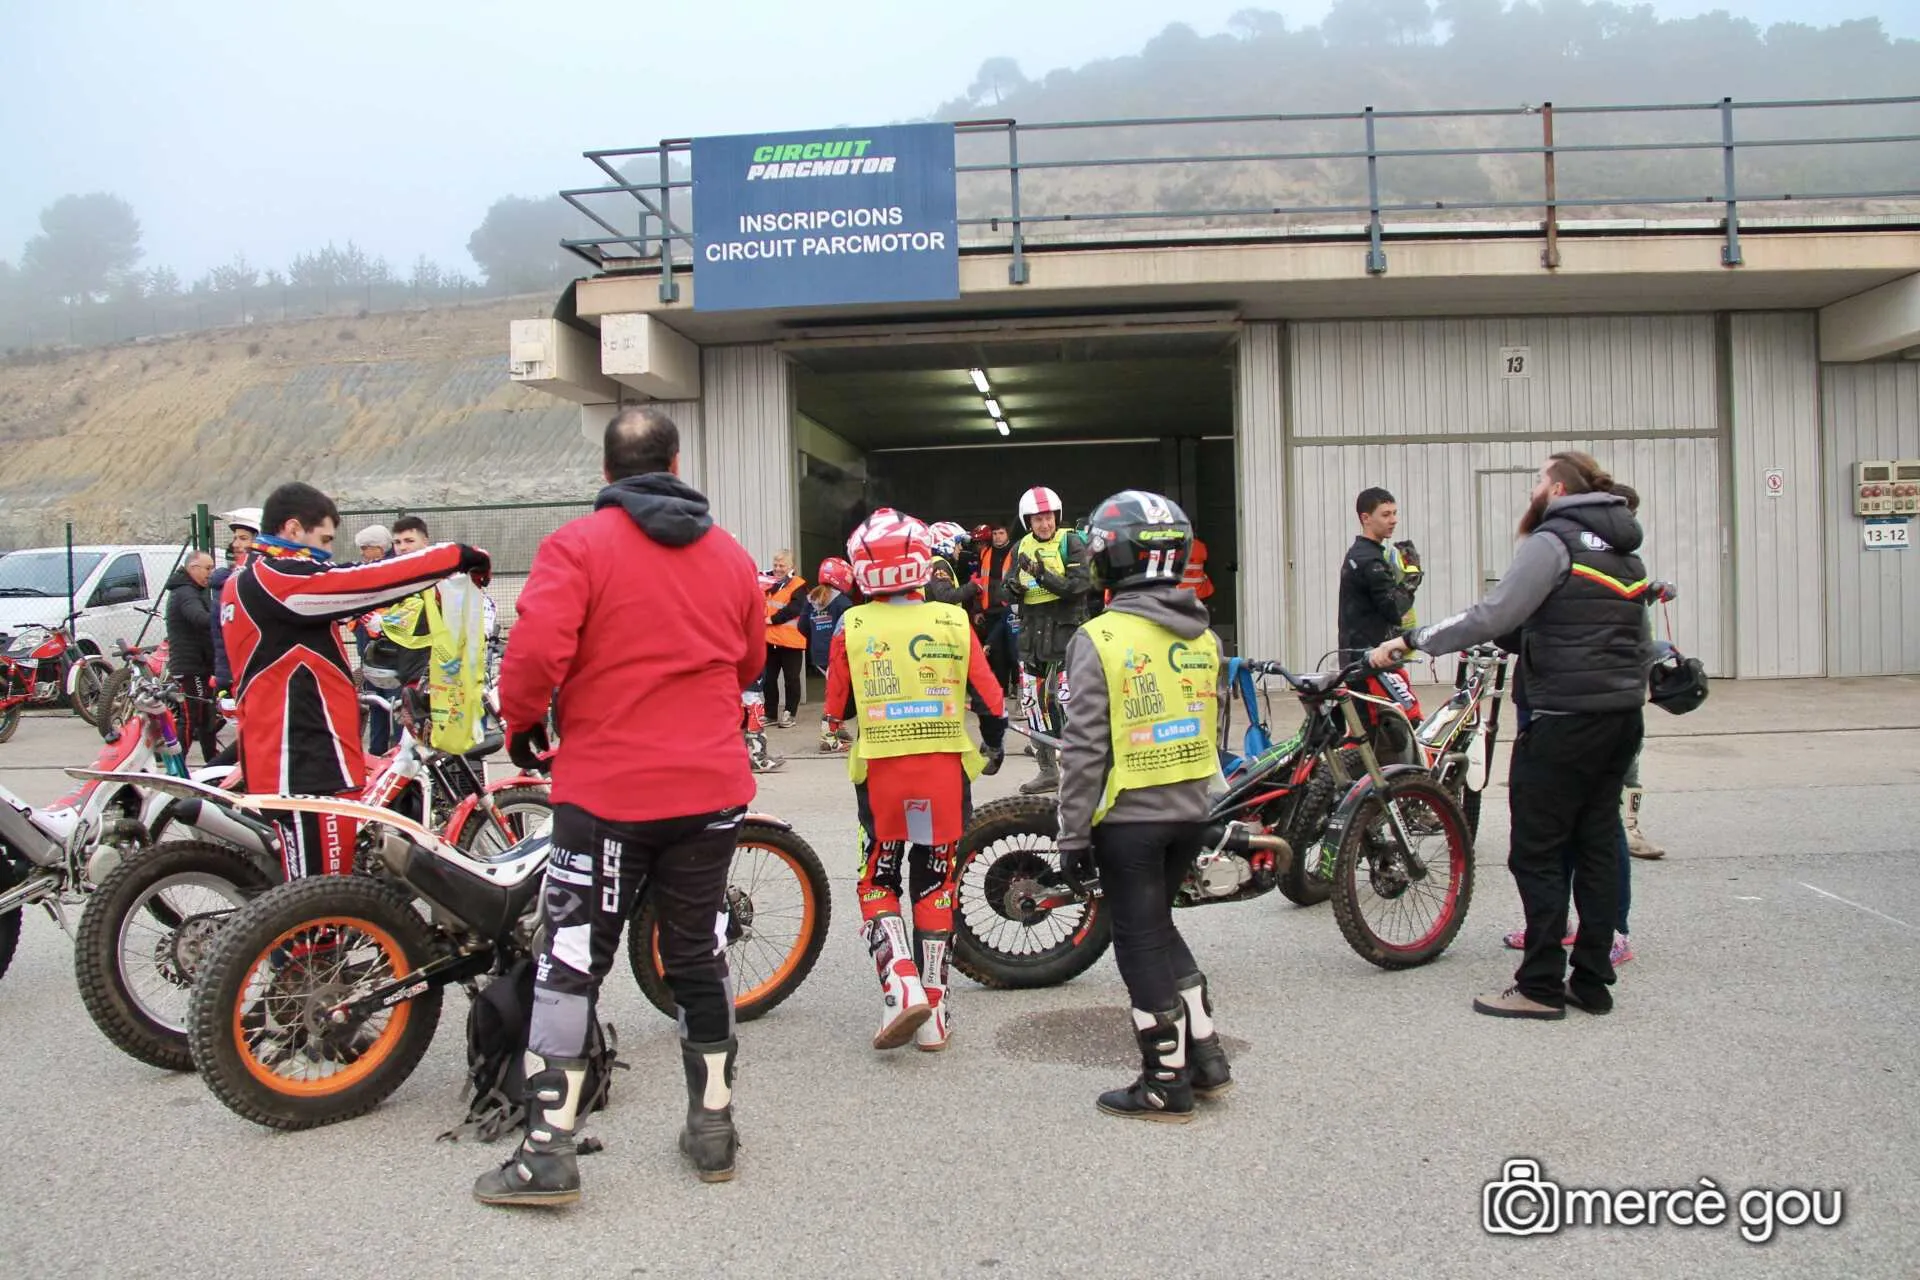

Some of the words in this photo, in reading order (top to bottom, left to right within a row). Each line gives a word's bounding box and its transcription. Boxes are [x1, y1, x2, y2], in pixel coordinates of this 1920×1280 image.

[752, 139, 872, 163] CIRCUIT
[746, 156, 897, 181] PARCMOTOR
[739, 207, 904, 233] INSCRIPCIONS
[705, 239, 796, 262] CIRCUIT
[802, 232, 945, 256] PARCMOTOR
[1506, 356, 1525, 373] 13
[1866, 529, 1906, 542] 13-12
[602, 838, 622, 913] CLICE
